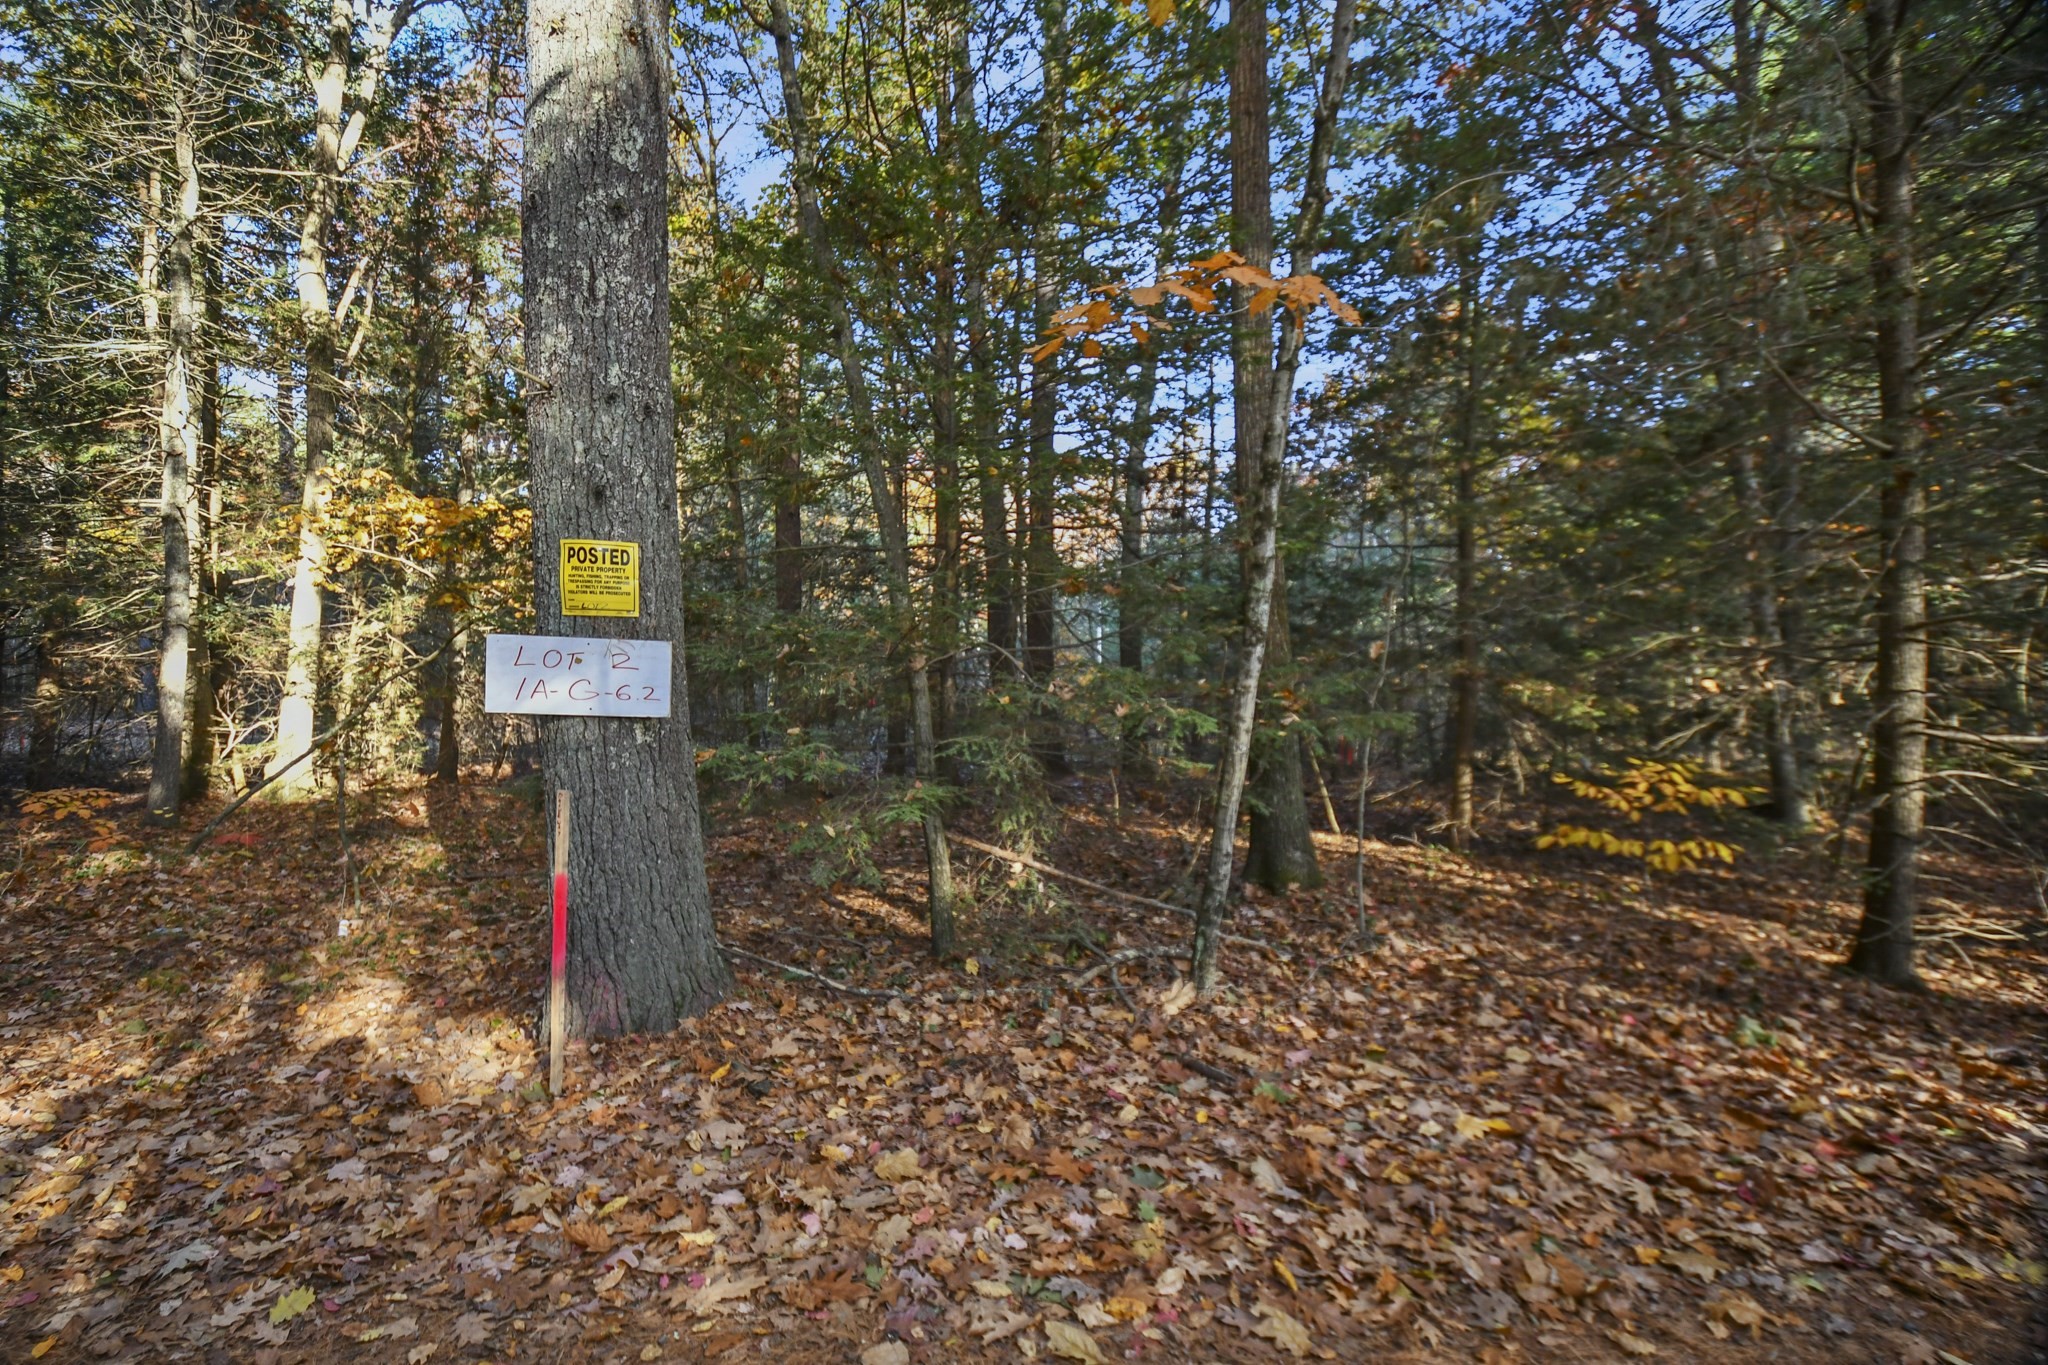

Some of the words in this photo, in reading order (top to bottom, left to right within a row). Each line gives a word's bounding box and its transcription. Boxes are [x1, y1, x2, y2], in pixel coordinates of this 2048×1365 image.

[567, 546, 631, 566] POSTED
[571, 565, 595, 573] PRIVATE
[596, 566, 626, 574] PROPERTY
[513, 645, 585, 671] LOT
[611, 652, 640, 671] 2
